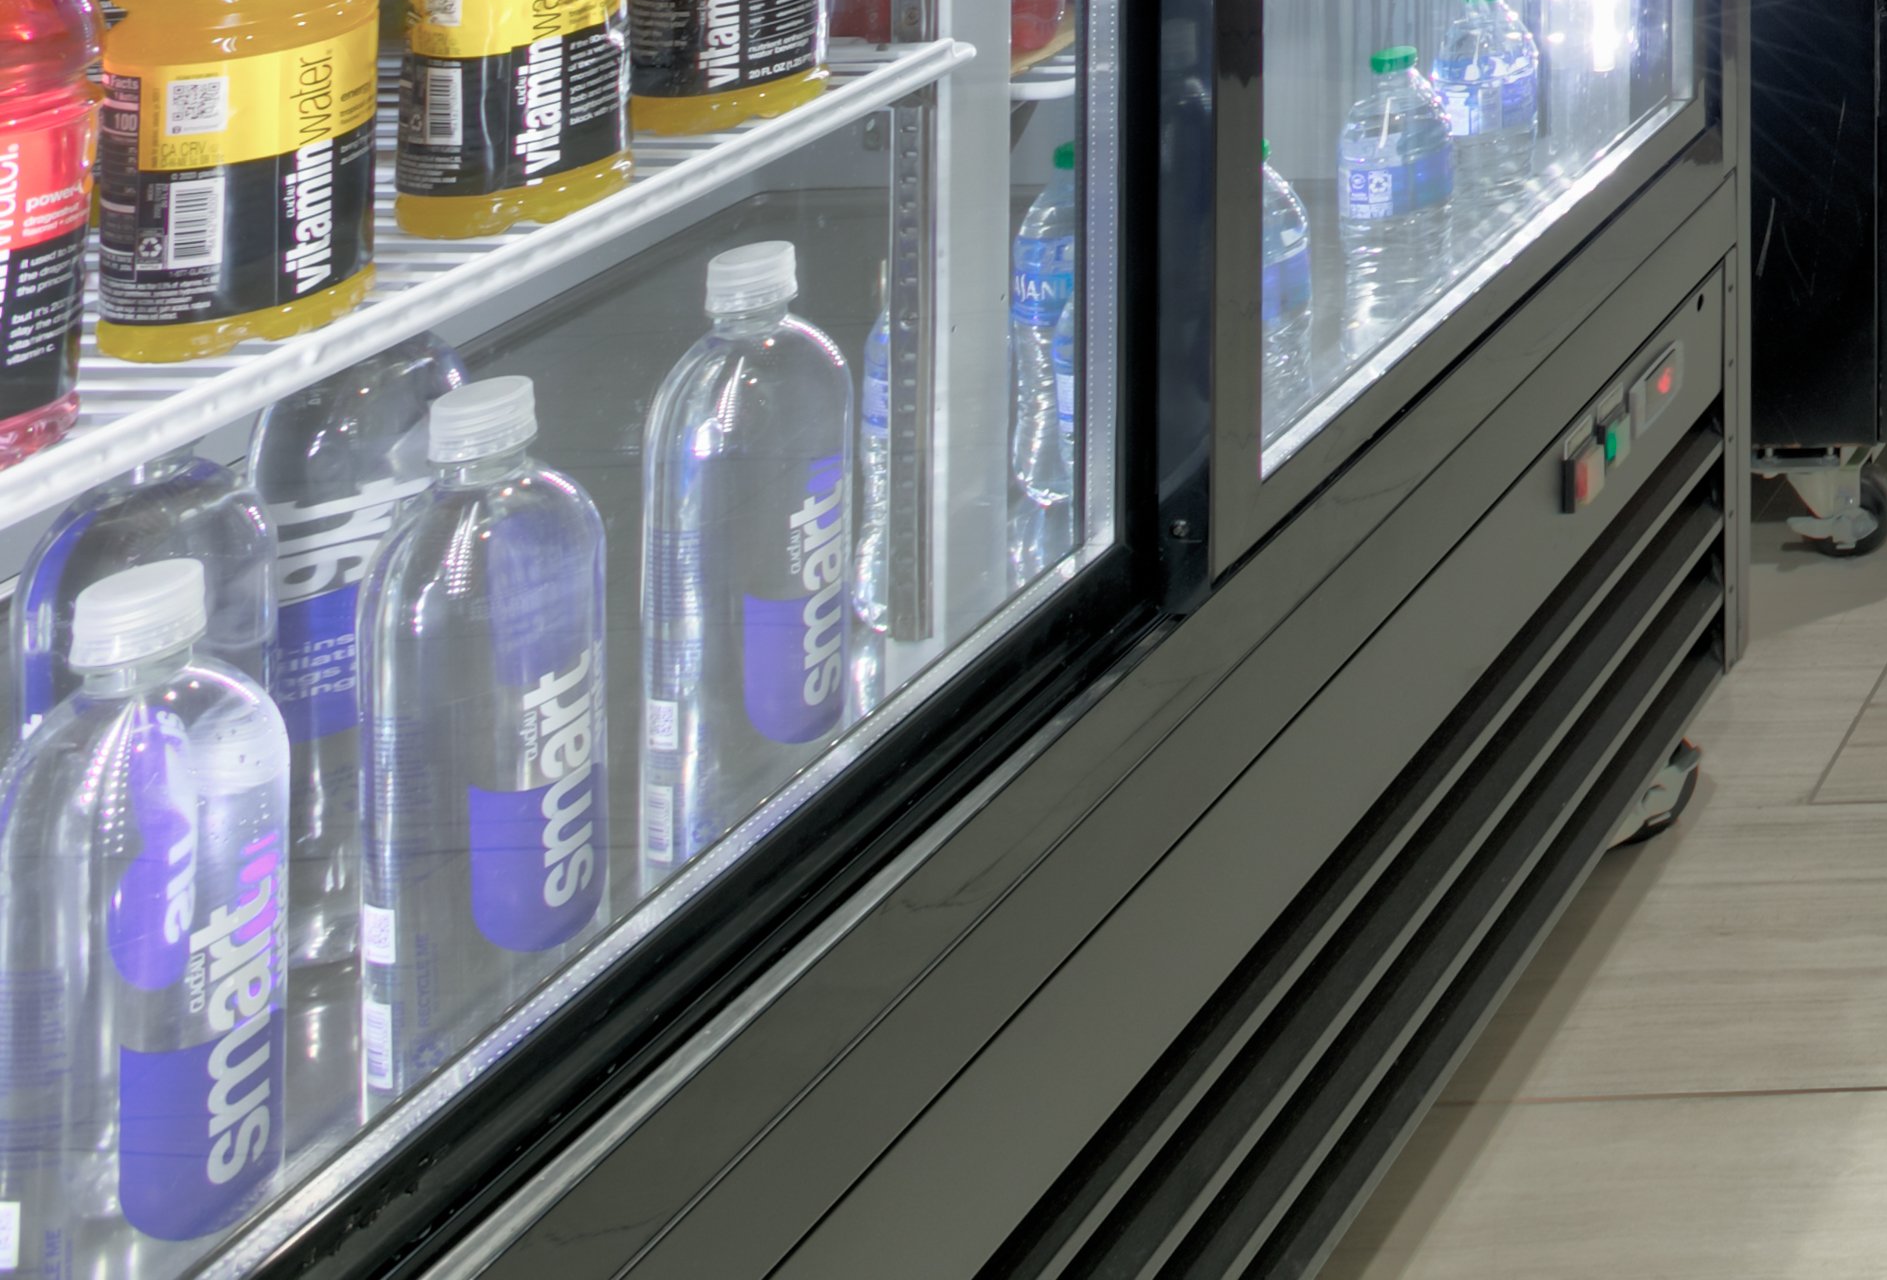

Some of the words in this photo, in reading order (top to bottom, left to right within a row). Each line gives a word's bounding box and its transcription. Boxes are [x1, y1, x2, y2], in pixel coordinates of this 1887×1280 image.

[114, 114, 138, 131] 100
[285, 57, 333, 294] vitaminwater
[790, 479, 843, 706] smart
[523, 648, 597, 908] smart
[189, 876, 273, 1184] smart
